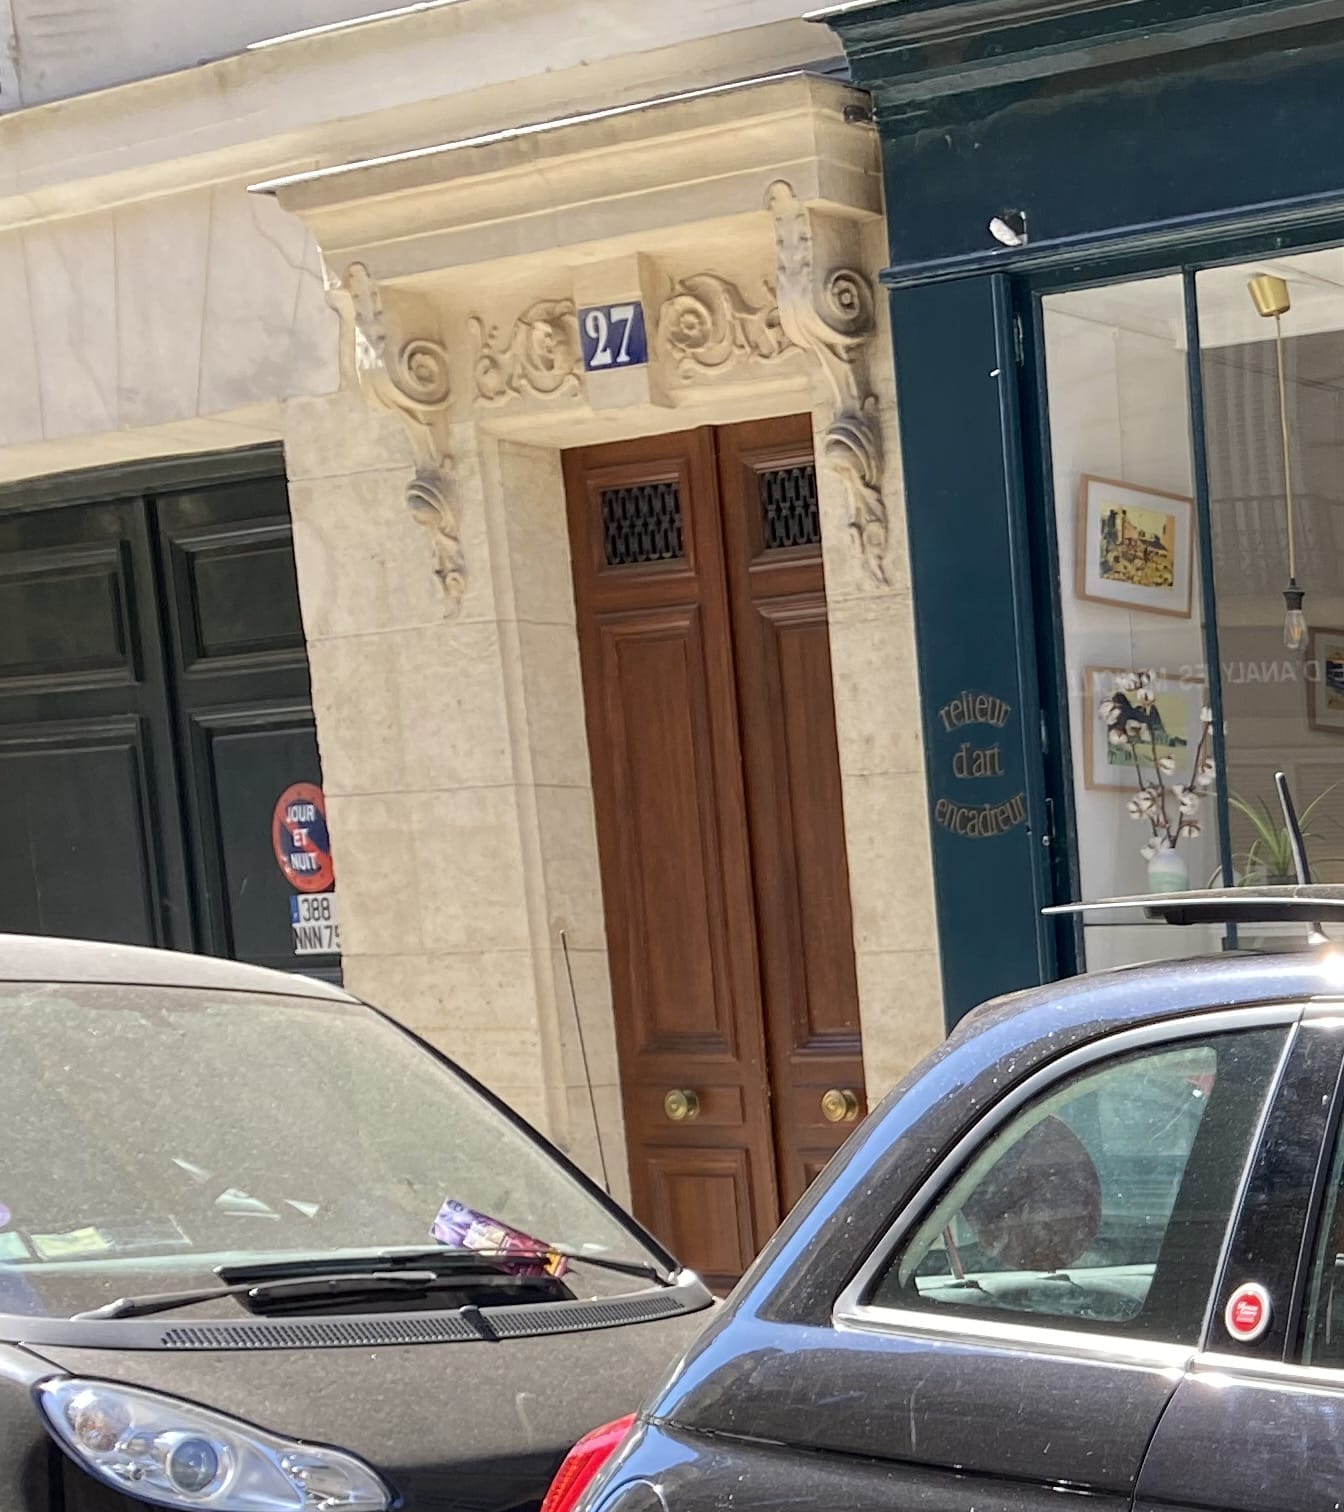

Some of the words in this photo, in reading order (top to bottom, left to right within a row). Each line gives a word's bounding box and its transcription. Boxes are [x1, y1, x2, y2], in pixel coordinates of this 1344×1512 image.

[585, 305, 634, 366] 27
[939, 690, 1012, 732] relieur
[952, 742, 1006, 778] d'art
[286, 804, 315, 823] JOUR
[935, 792, 1026, 838] encadreur
[292, 828, 309, 847] ET
[290, 852, 318, 871] NUIT
[301, 897, 332, 922] 388
